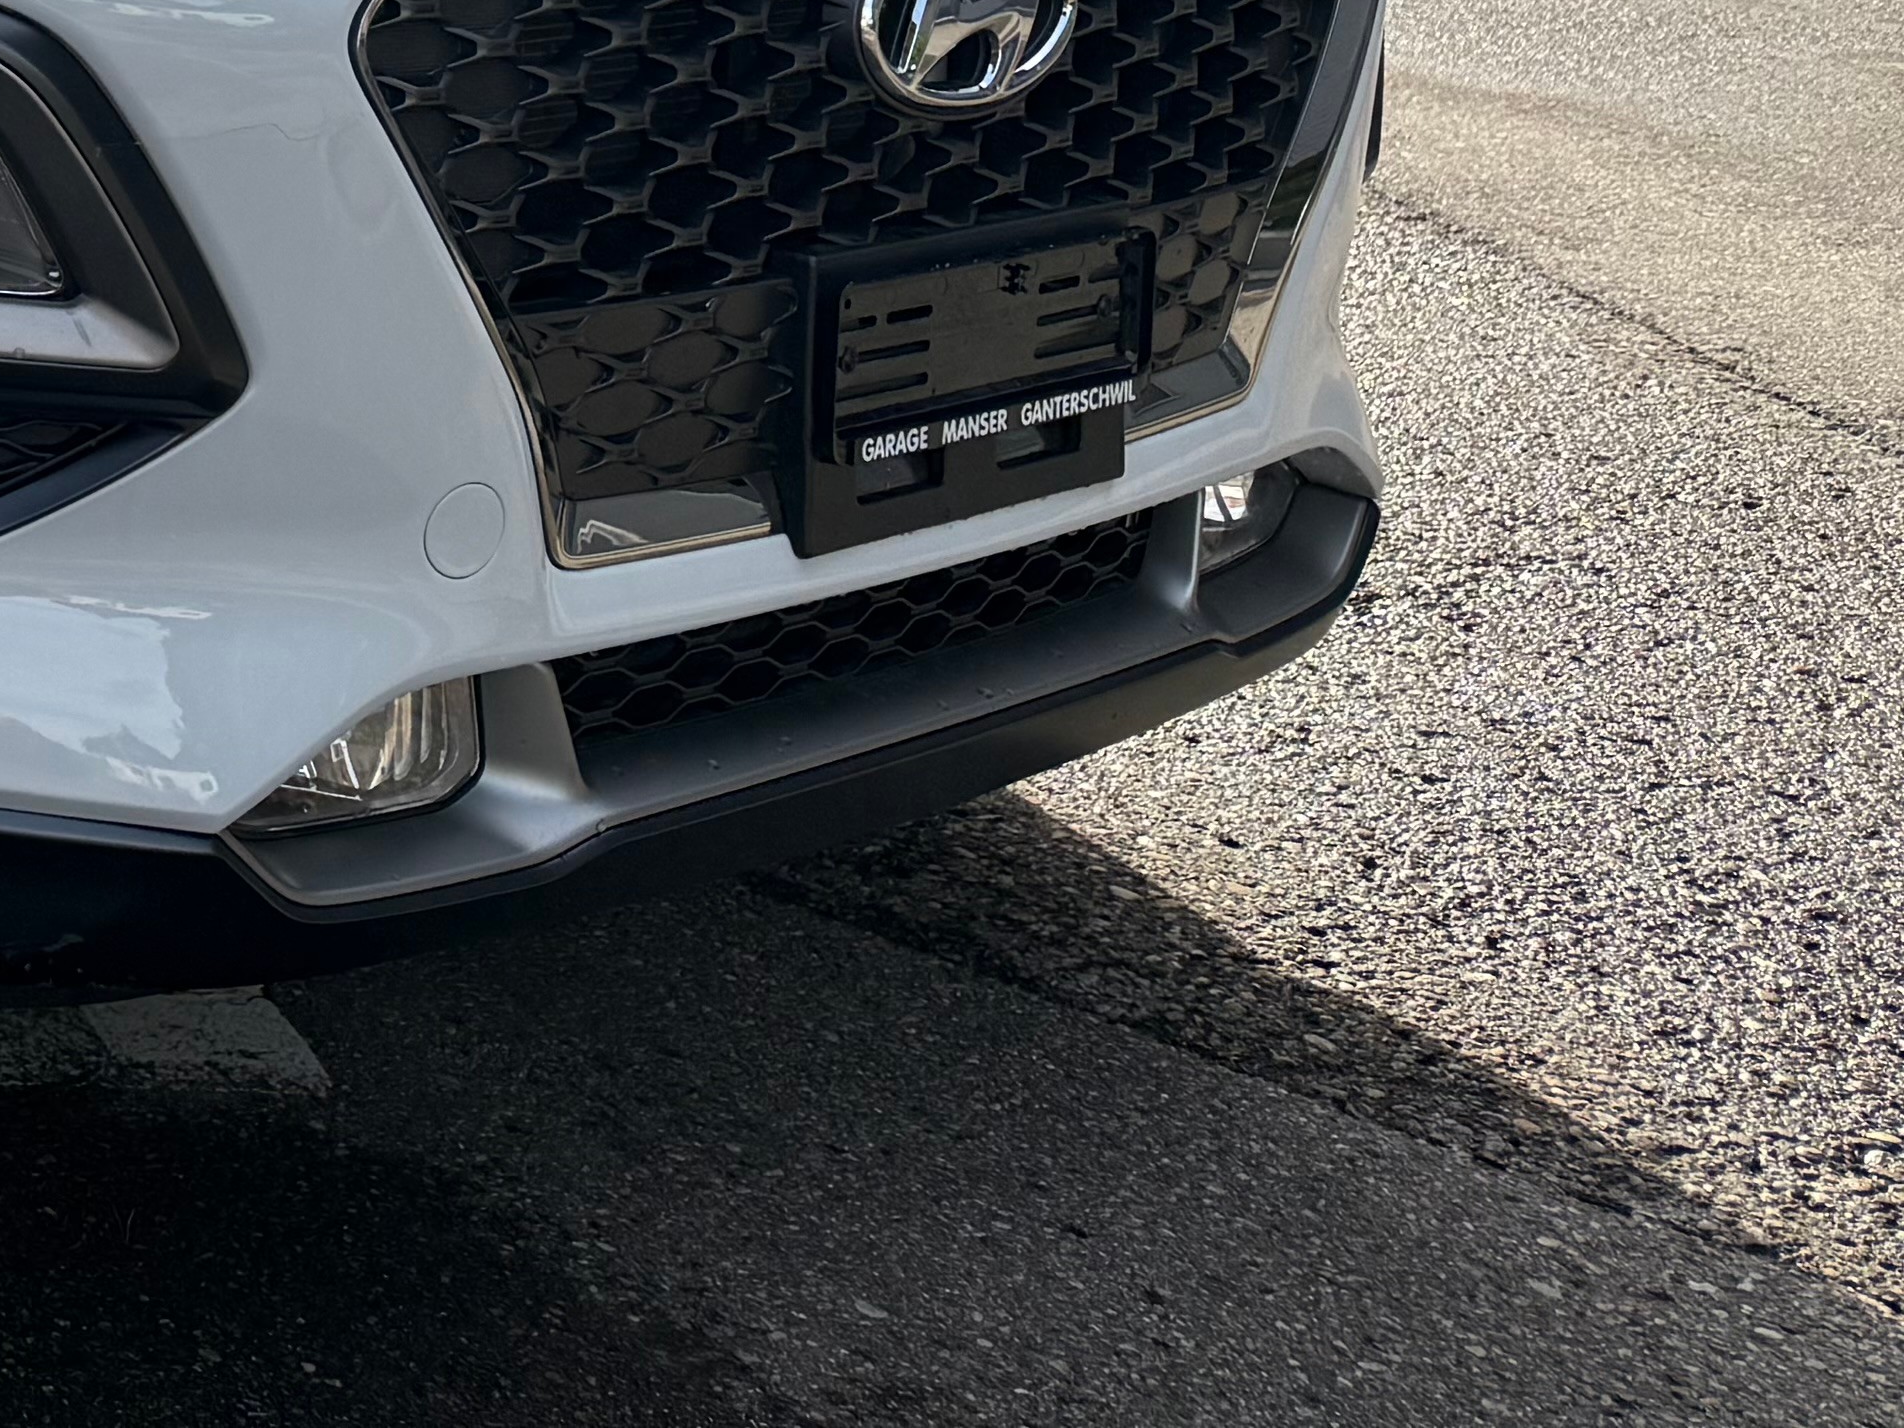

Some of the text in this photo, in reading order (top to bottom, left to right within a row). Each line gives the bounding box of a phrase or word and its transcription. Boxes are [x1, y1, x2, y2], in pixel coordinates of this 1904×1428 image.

[861, 378, 1137, 463] GARAGE MANSER GANTERSCHWIL
